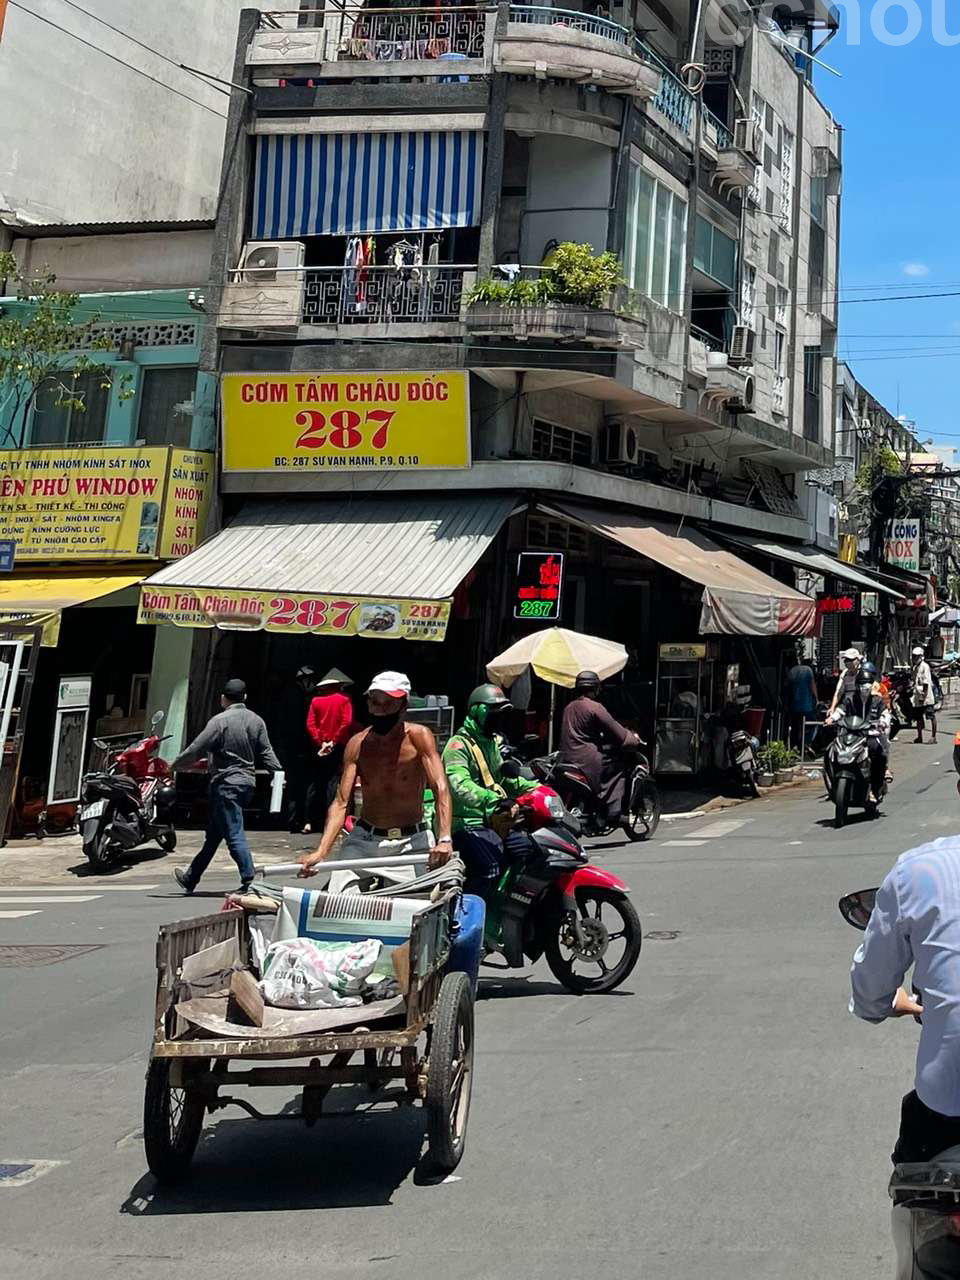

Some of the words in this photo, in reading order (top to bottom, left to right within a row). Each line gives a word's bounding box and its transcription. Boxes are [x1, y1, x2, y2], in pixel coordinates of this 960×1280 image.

[241, 380, 289, 403] CƠM
[295, 375, 339, 402] TẤM
[345, 378, 401, 402] CHÂU
[407, 374, 449, 401] ĐỐC
[294, 409, 397, 449] 287
[26, 459, 50, 470] TNHH
[129, 459, 151, 469] INOX
[293, 456, 309, 466] 287
[31, 472, 71, 497] PHÚ
[76, 477, 159, 497] WINDOW
[175, 504, 199, 520] KÍNH
[171, 542, 195, 556] INOX
[885, 541, 913, 557] NOX
[266, 597, 360, 629] 287
[409, 603, 444, 619] 287
[519, 600, 554, 617] 287
